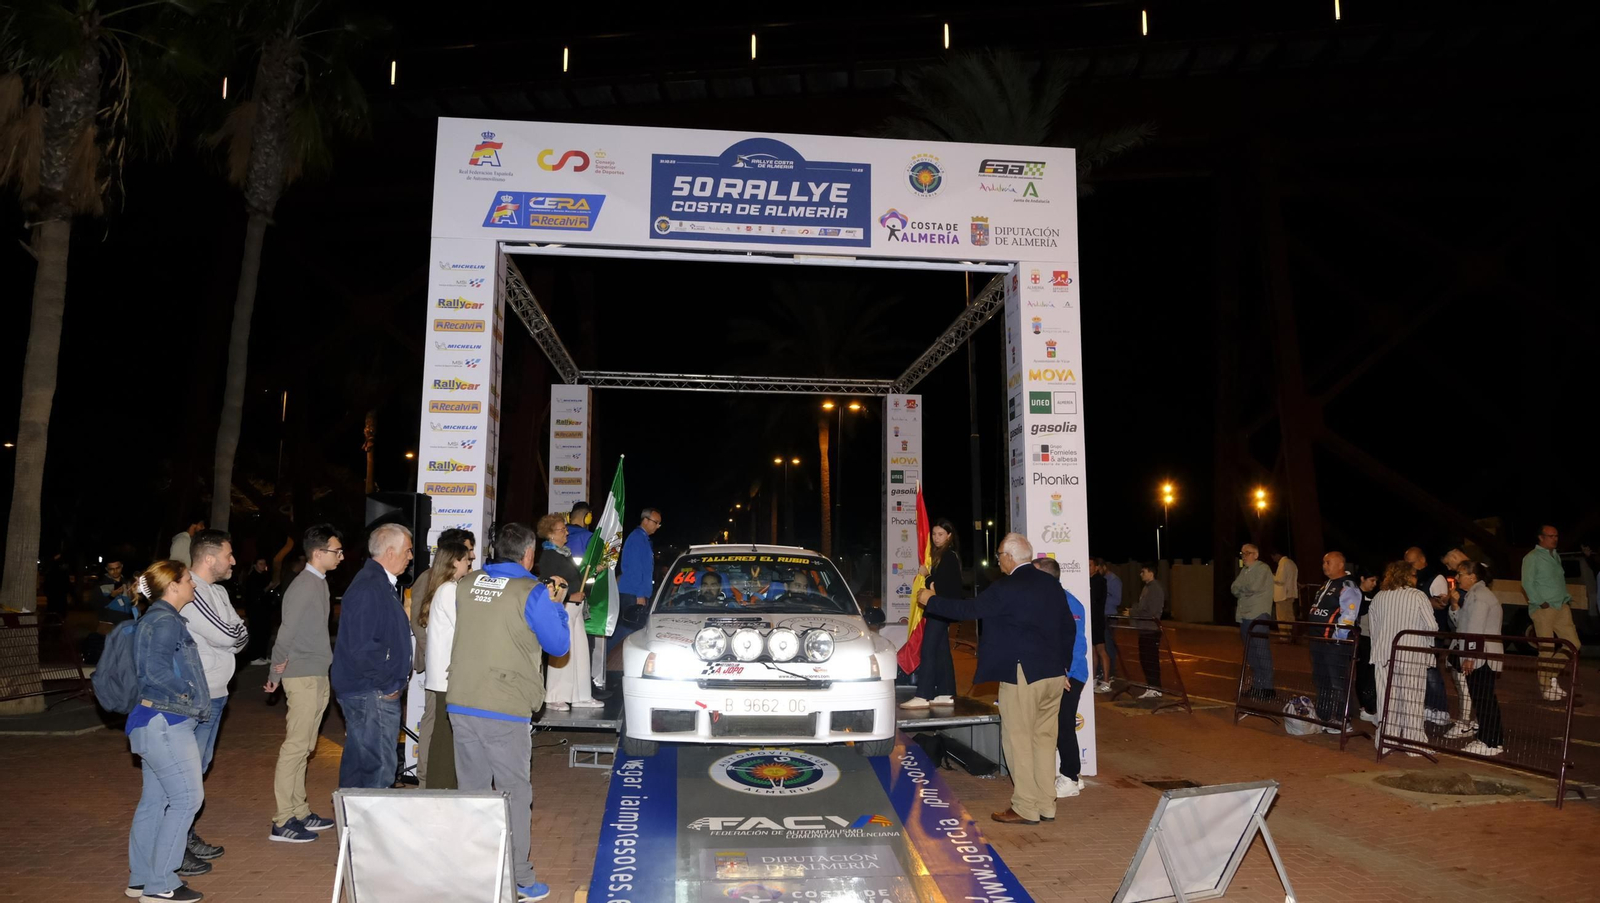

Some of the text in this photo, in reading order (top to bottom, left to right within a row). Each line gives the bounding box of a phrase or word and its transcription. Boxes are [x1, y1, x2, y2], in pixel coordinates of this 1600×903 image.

[672, 176, 851, 203] 50 RALLYE
[529, 197, 590, 210] CERA
[671, 201, 848, 219] COSTA DE ALMERÍA
[541, 216, 578, 226] Recalvi
[911, 221, 958, 231] COSTA DE
[995, 226, 1060, 237] DIPUTACIÓN
[901, 231, 960, 245] ALMERÍA
[995, 236, 1058, 247] DE ALMERÍA
[438, 298, 484, 309] Rallycar
[444, 322, 476, 330] Recalvi
[1029, 369, 1076, 381] MOYA
[434, 379, 480, 390] Rallycar
[439, 403, 471, 411] Recalvi
[1031, 422, 1077, 435] gasolia
[429, 461, 476, 472] Rallycar
[1033, 472, 1079, 485] Phonika
[434, 485, 466, 493] Recalvi
[674, 572, 696, 584] 64
[470, 588, 503, 597] FOTO/TV
[725, 698, 806, 712] B 9662 OG
[800, 754, 828, 767] CLUB
[762, 853, 878, 863] DIPUTACIÓN
[796, 862, 880, 871] ALMERÍA
